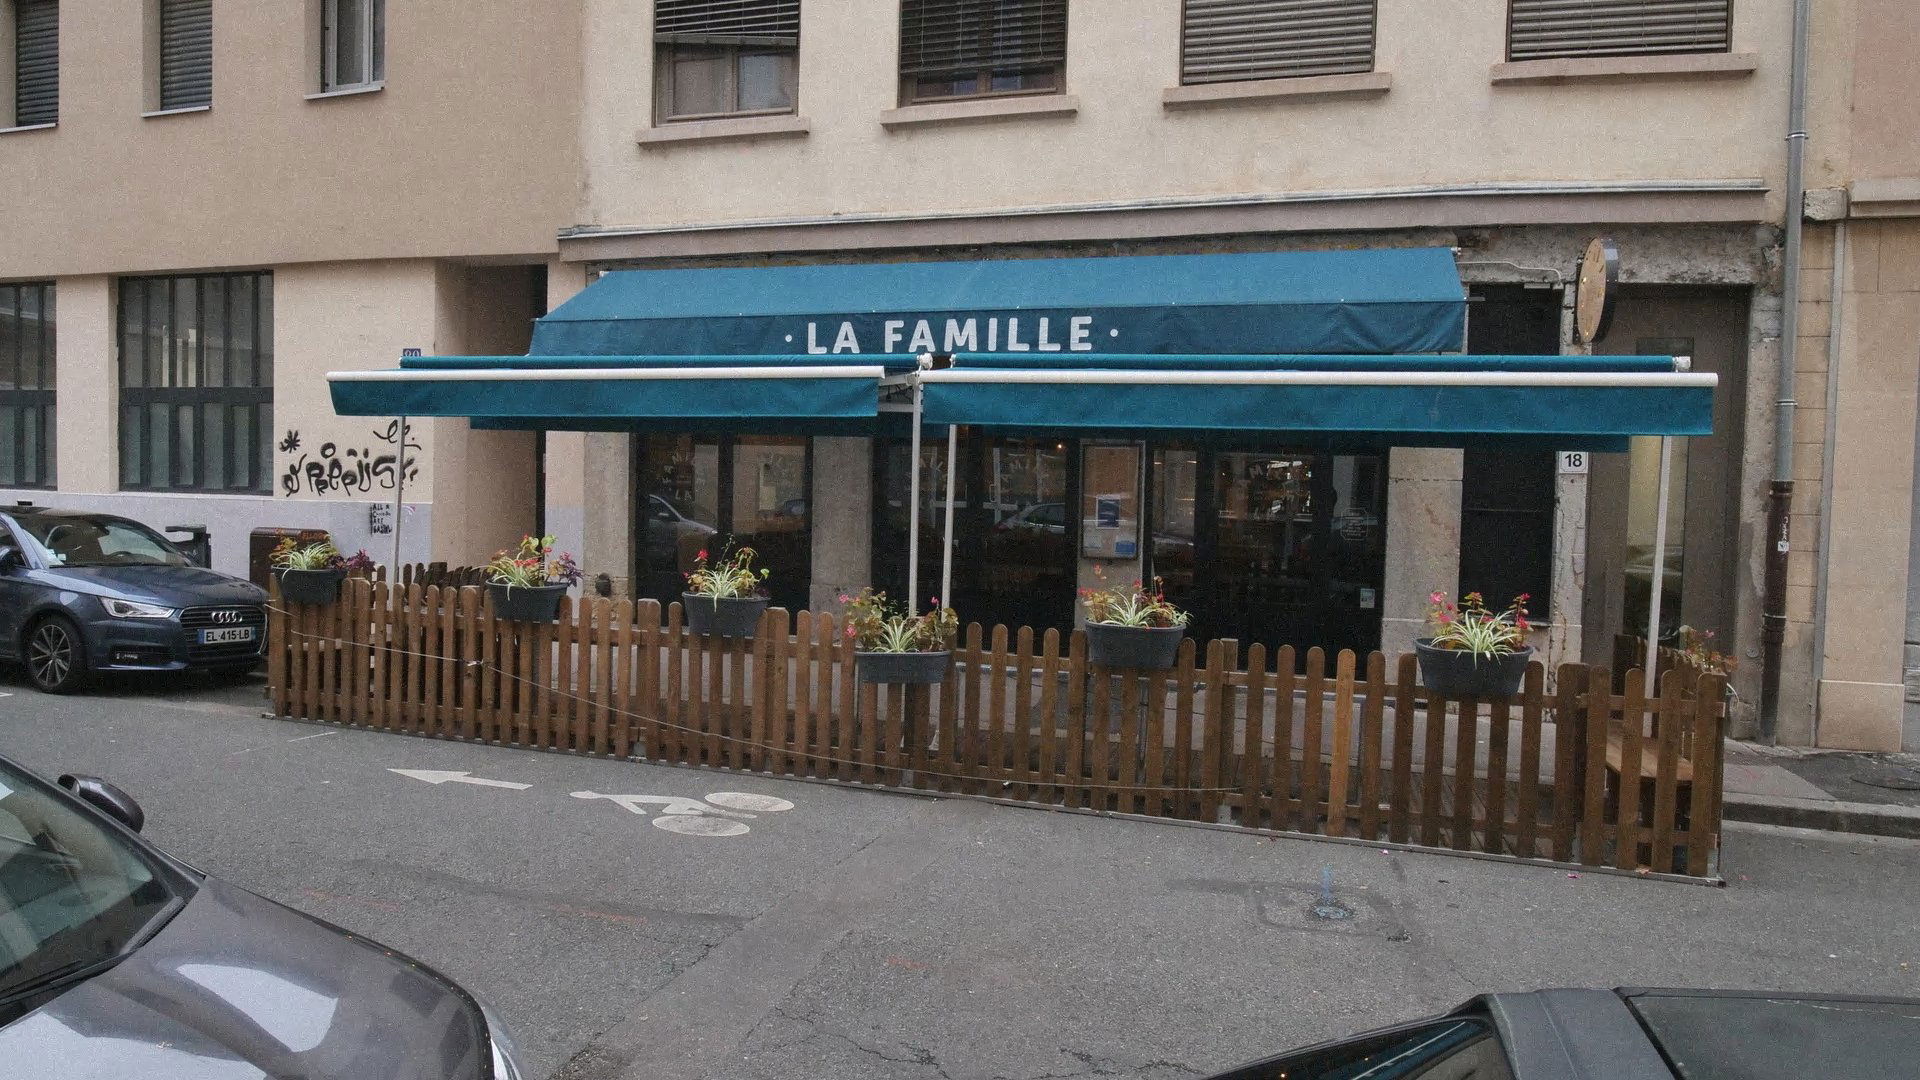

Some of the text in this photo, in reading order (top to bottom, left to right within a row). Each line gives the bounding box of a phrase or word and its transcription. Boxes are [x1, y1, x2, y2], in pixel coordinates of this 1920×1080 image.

[807, 315, 1092, 354] LA FAMILLE
[1564, 453, 1583, 468] 18
